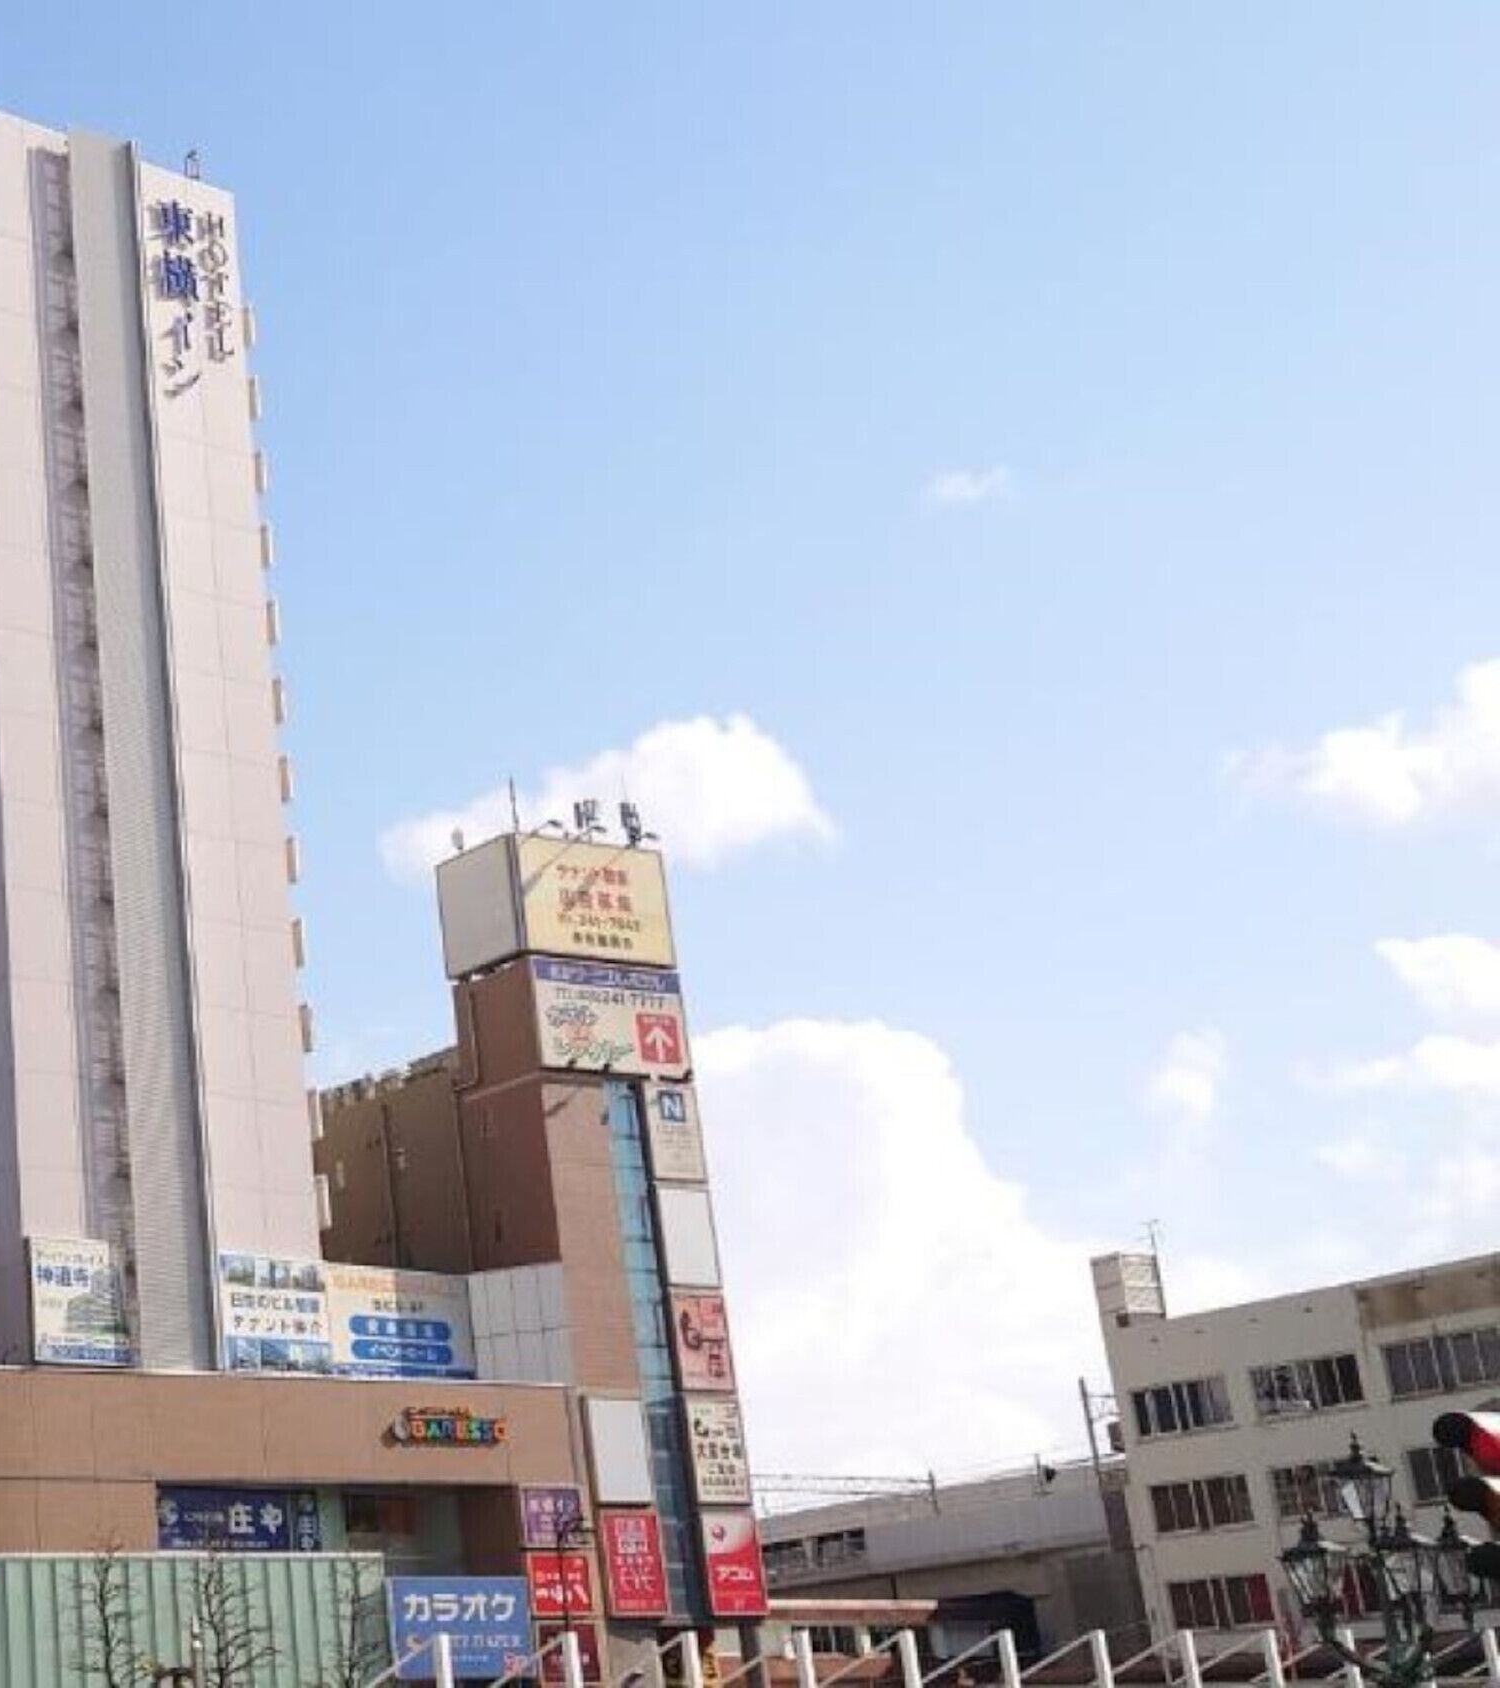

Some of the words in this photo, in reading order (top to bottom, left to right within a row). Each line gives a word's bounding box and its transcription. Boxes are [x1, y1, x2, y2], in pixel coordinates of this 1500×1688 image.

[154, 200, 201, 398] 東横イン
[228, 1502, 283, 1535] 庄や
[403, 1593, 517, 1622] カラオケ
